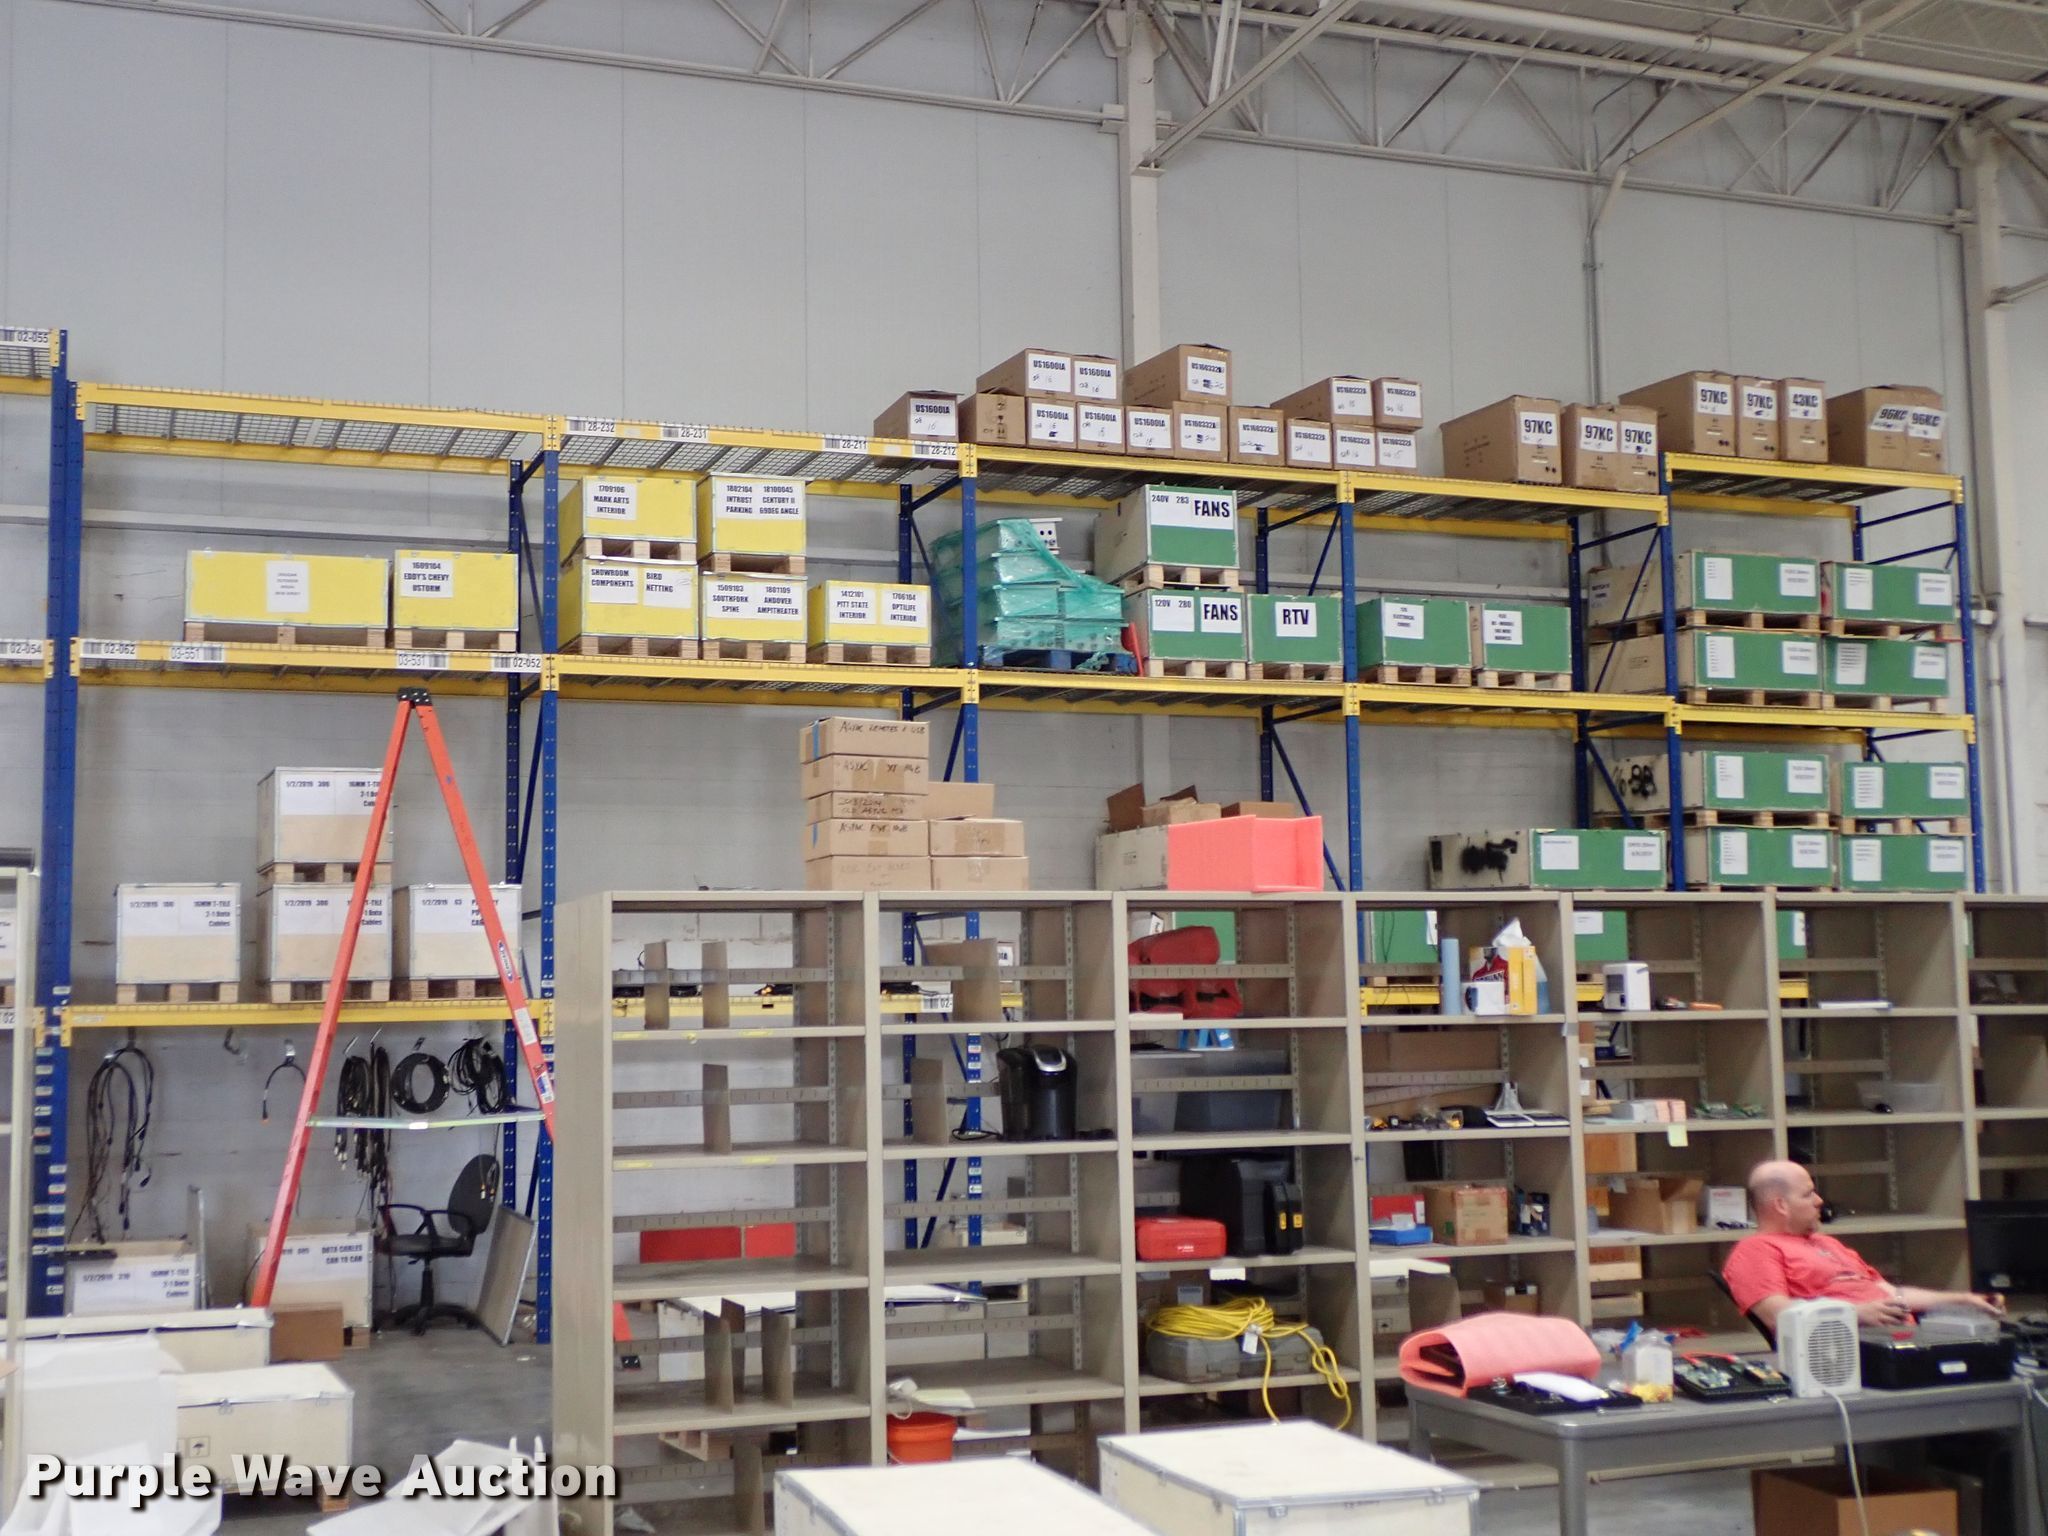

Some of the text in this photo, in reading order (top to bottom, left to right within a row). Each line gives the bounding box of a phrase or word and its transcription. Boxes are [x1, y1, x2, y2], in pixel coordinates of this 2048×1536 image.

[17, 332, 49, 344] 02-055
[1701, 388, 1728, 405] 97KC
[1747, 393, 1774, 410] 97KC
[1792, 393, 1819, 408] 43KC
[588, 421, 615, 433] 28-232
[1524, 418, 1552, 435] 97KC
[680, 427, 706, 439] 28-231
[1585, 424, 1613, 442] 97KC
[1624, 428, 1652, 445] 97KC
[842, 439, 867, 450] 28-211
[931, 445, 956, 456] 28-212
[593, 495, 630, 504] MARK ARTS
[1151, 494, 1190, 504] 240V 283
[596, 506, 626, 515] INTERIOR
[726, 506, 753, 514] PARKING
[780, 507, 799, 515] ANGLE
[1194, 500, 1230, 518] FANS
[403, 572, 449, 582] EDDY'S CHEVY
[591, 569, 629, 577] SHOWROOM
[646, 572, 663, 581] BIRD
[591, 579, 634, 588] COMPONENTS
[646, 584, 673, 593] NETTING
[712, 595, 749, 603] SOUTHFORK
[764, 597, 793, 605] ANDOVER
[1155, 599, 1171, 607] 120V
[851, 601, 869, 609] STATE
[892, 603, 917, 611] OPTILIFE
[757, 607, 799, 615] AMPITHEATER
[1203, 604, 1239, 621] FANS
[890, 614, 918, 622] INTERIOR
[1282, 608, 1310, 625] RTV
[9, 643, 42, 654] 02-054
[513, 657, 541, 668] 02-052
